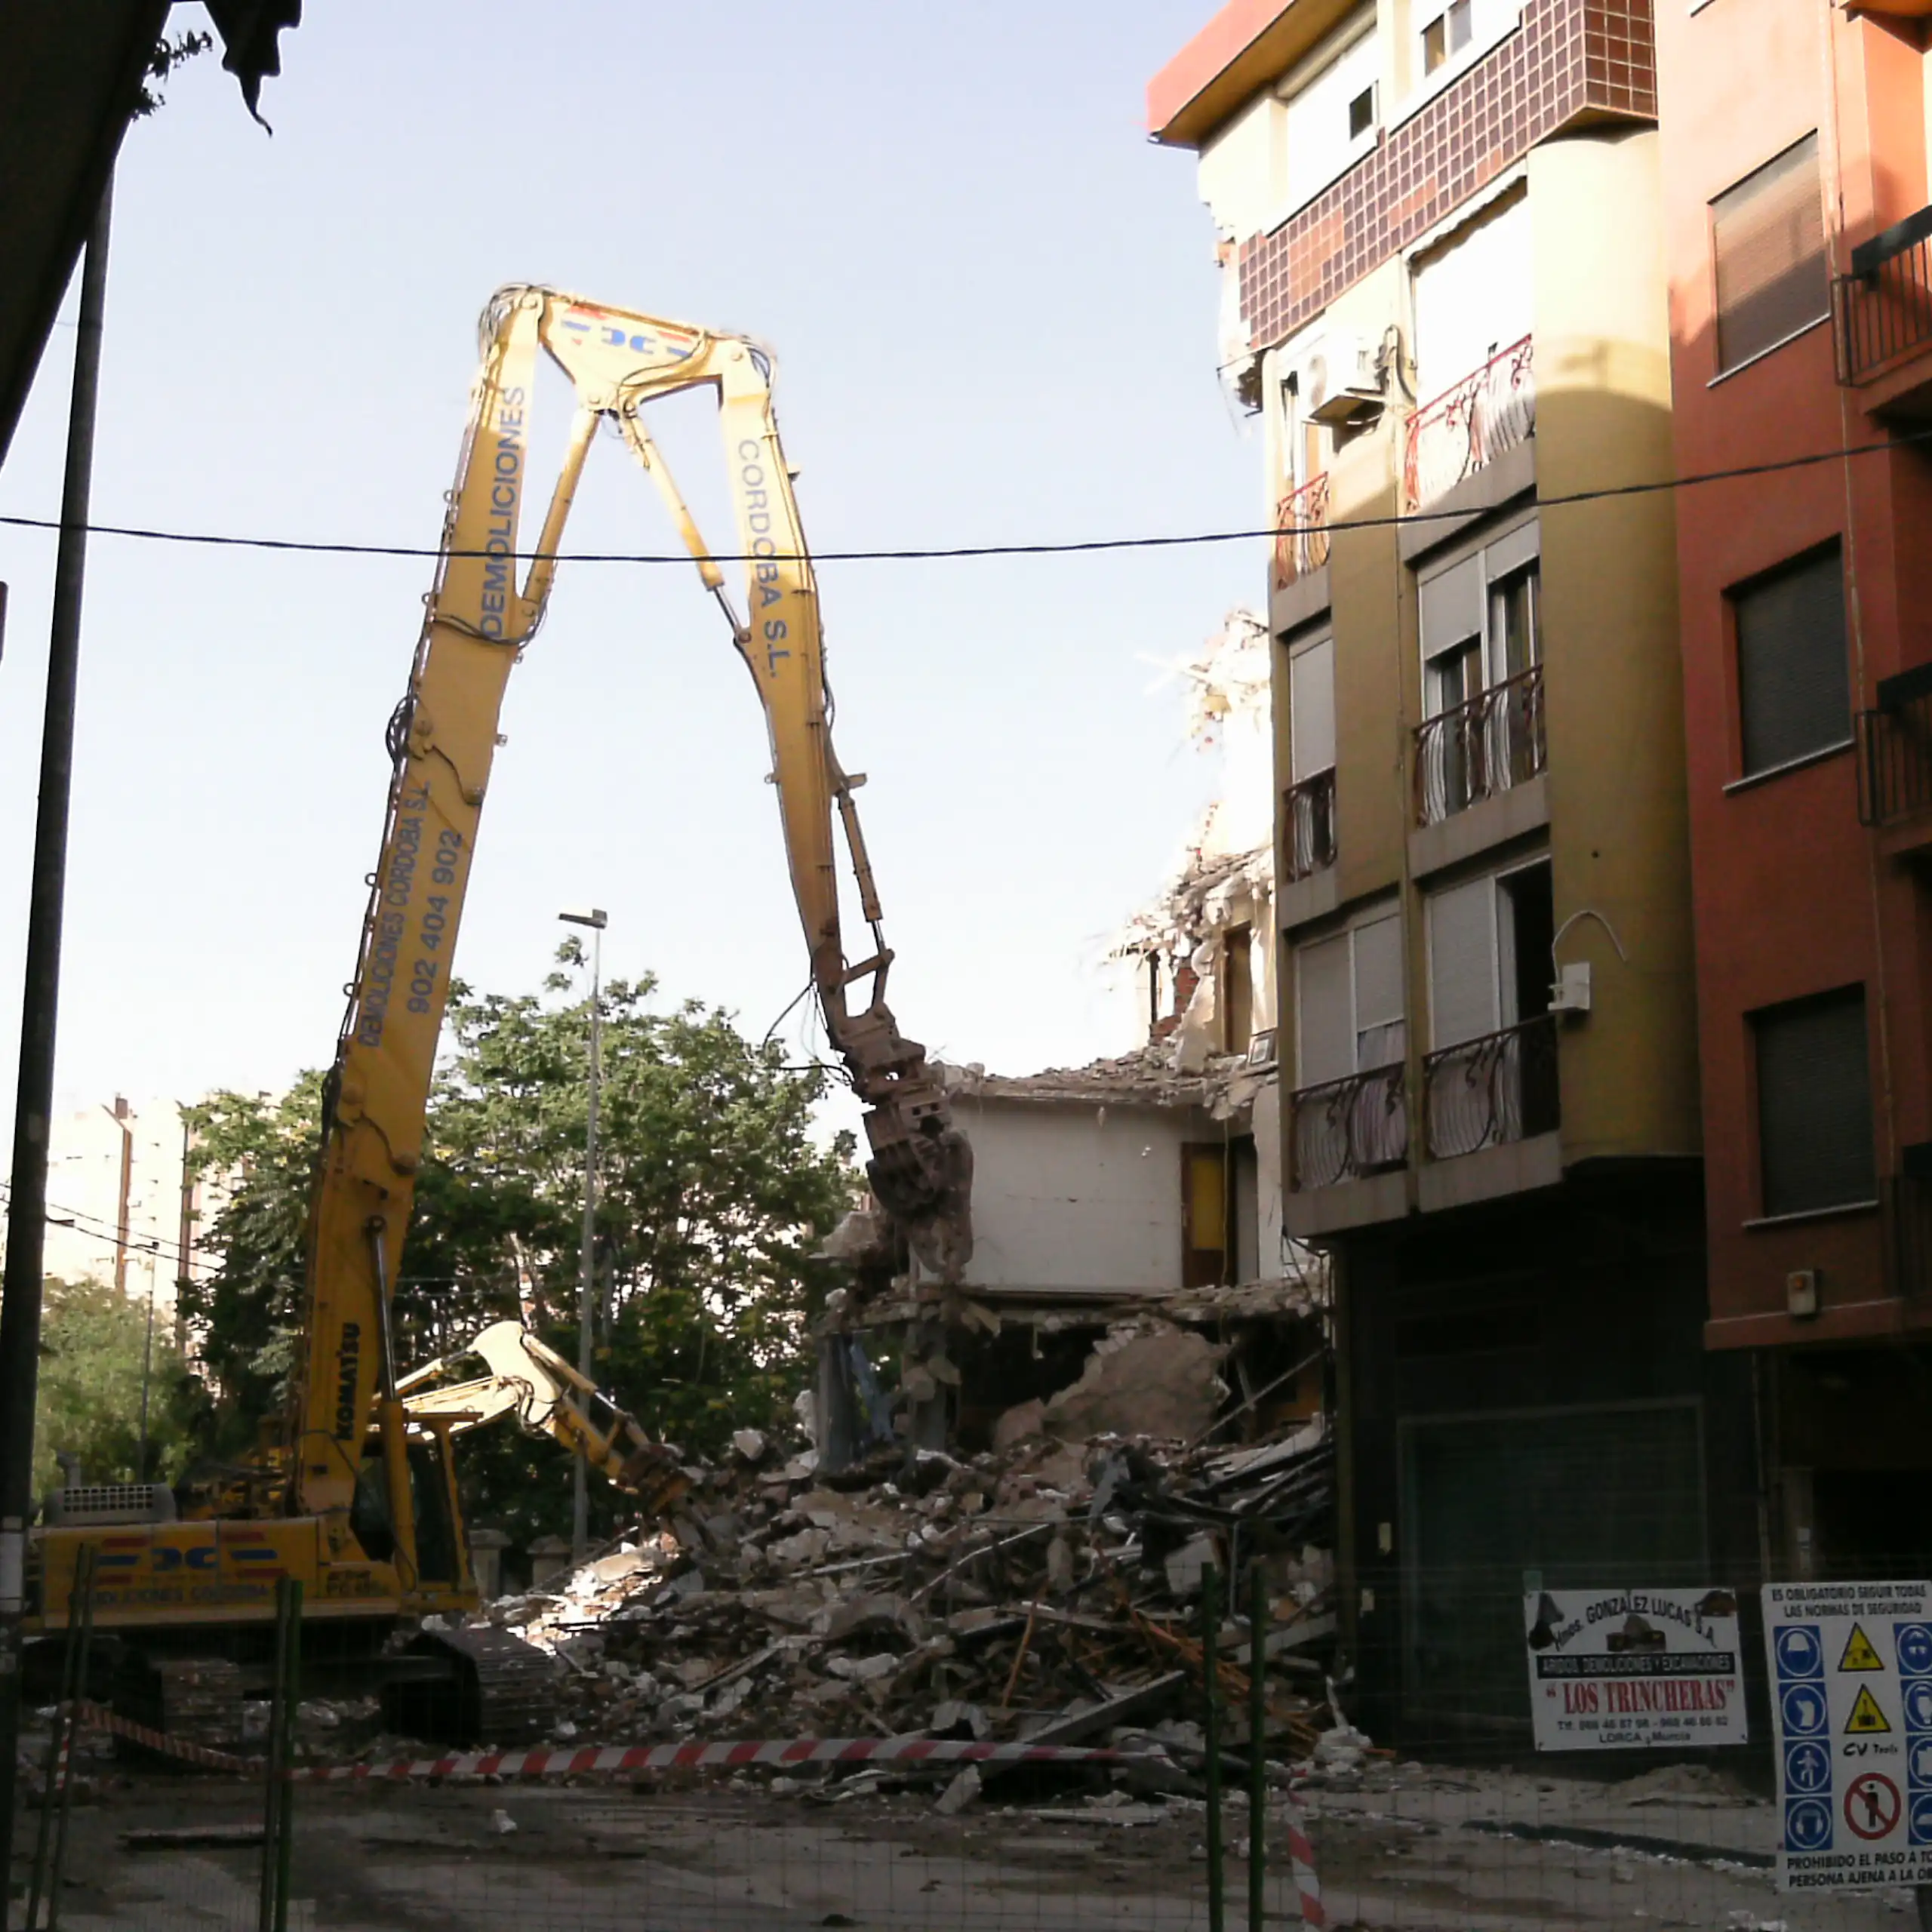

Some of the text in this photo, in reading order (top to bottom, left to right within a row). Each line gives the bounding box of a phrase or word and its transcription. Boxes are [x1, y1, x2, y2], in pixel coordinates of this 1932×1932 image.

[479, 386, 525, 638] DEMOLICIONES
[738, 439, 791, 678] CORDOBA S.L.
[358, 911, 405, 1048] DEMOLICIONES
[386, 817, 424, 907] CORDOBA
[407, 829, 464, 1015] 902 404 902
[337, 1322, 360, 1440] KOMATSU
[1772, 1585, 1927, 1601] ES OBLIGATORIO SEGUIR TODAS
[1651, 1597, 1690, 1627] LUCAS
[1784, 1602, 1922, 1617] LAS NORMAS DE SEGURIDAD
[1599, 1733, 1642, 1743] LORCA
[1843, 1743, 1868, 1757] CV
[1787, 1855, 1855, 1869] PROHIBIDO
[1860, 1854, 1872, 1866] EL
[1875, 1853, 1905, 1866] PASO
[1909, 1850, 1917, 1863] A
[1789, 1872, 1844, 1887] PERSONA
[1847, 1870, 1885, 1884] AJENA
[1888, 1870, 1897, 1881] A
[1900, 1869, 1914, 1881] LA
